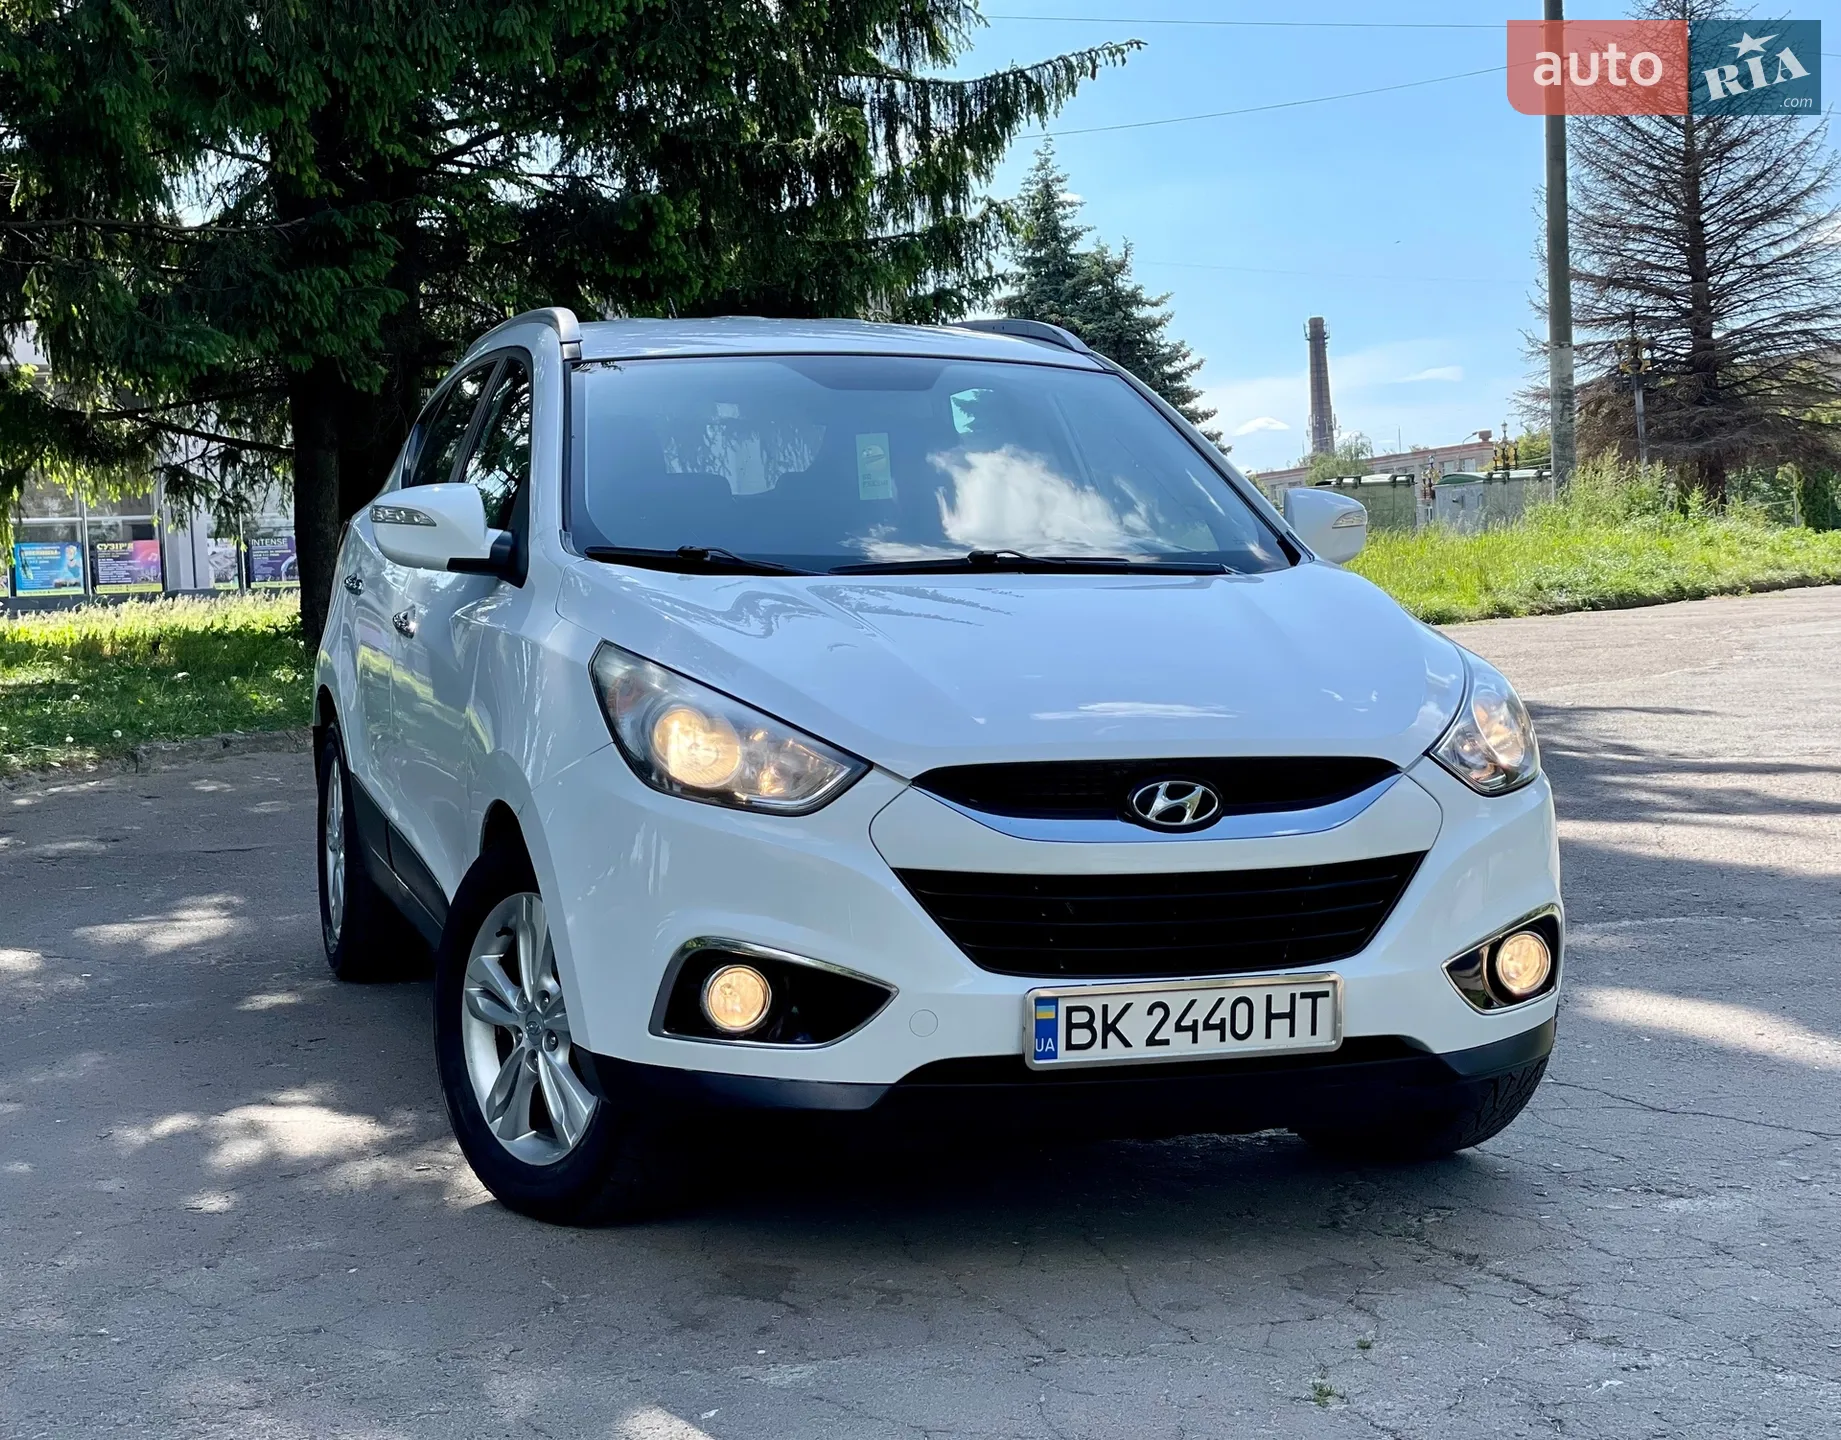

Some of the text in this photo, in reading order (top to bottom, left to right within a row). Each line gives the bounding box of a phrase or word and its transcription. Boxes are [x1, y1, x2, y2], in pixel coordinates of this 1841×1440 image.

[251, 537, 288, 546] INTENSE
[1064, 990, 1330, 1051] BK 2440 HT
[1035, 1037, 1055, 1053] UA
